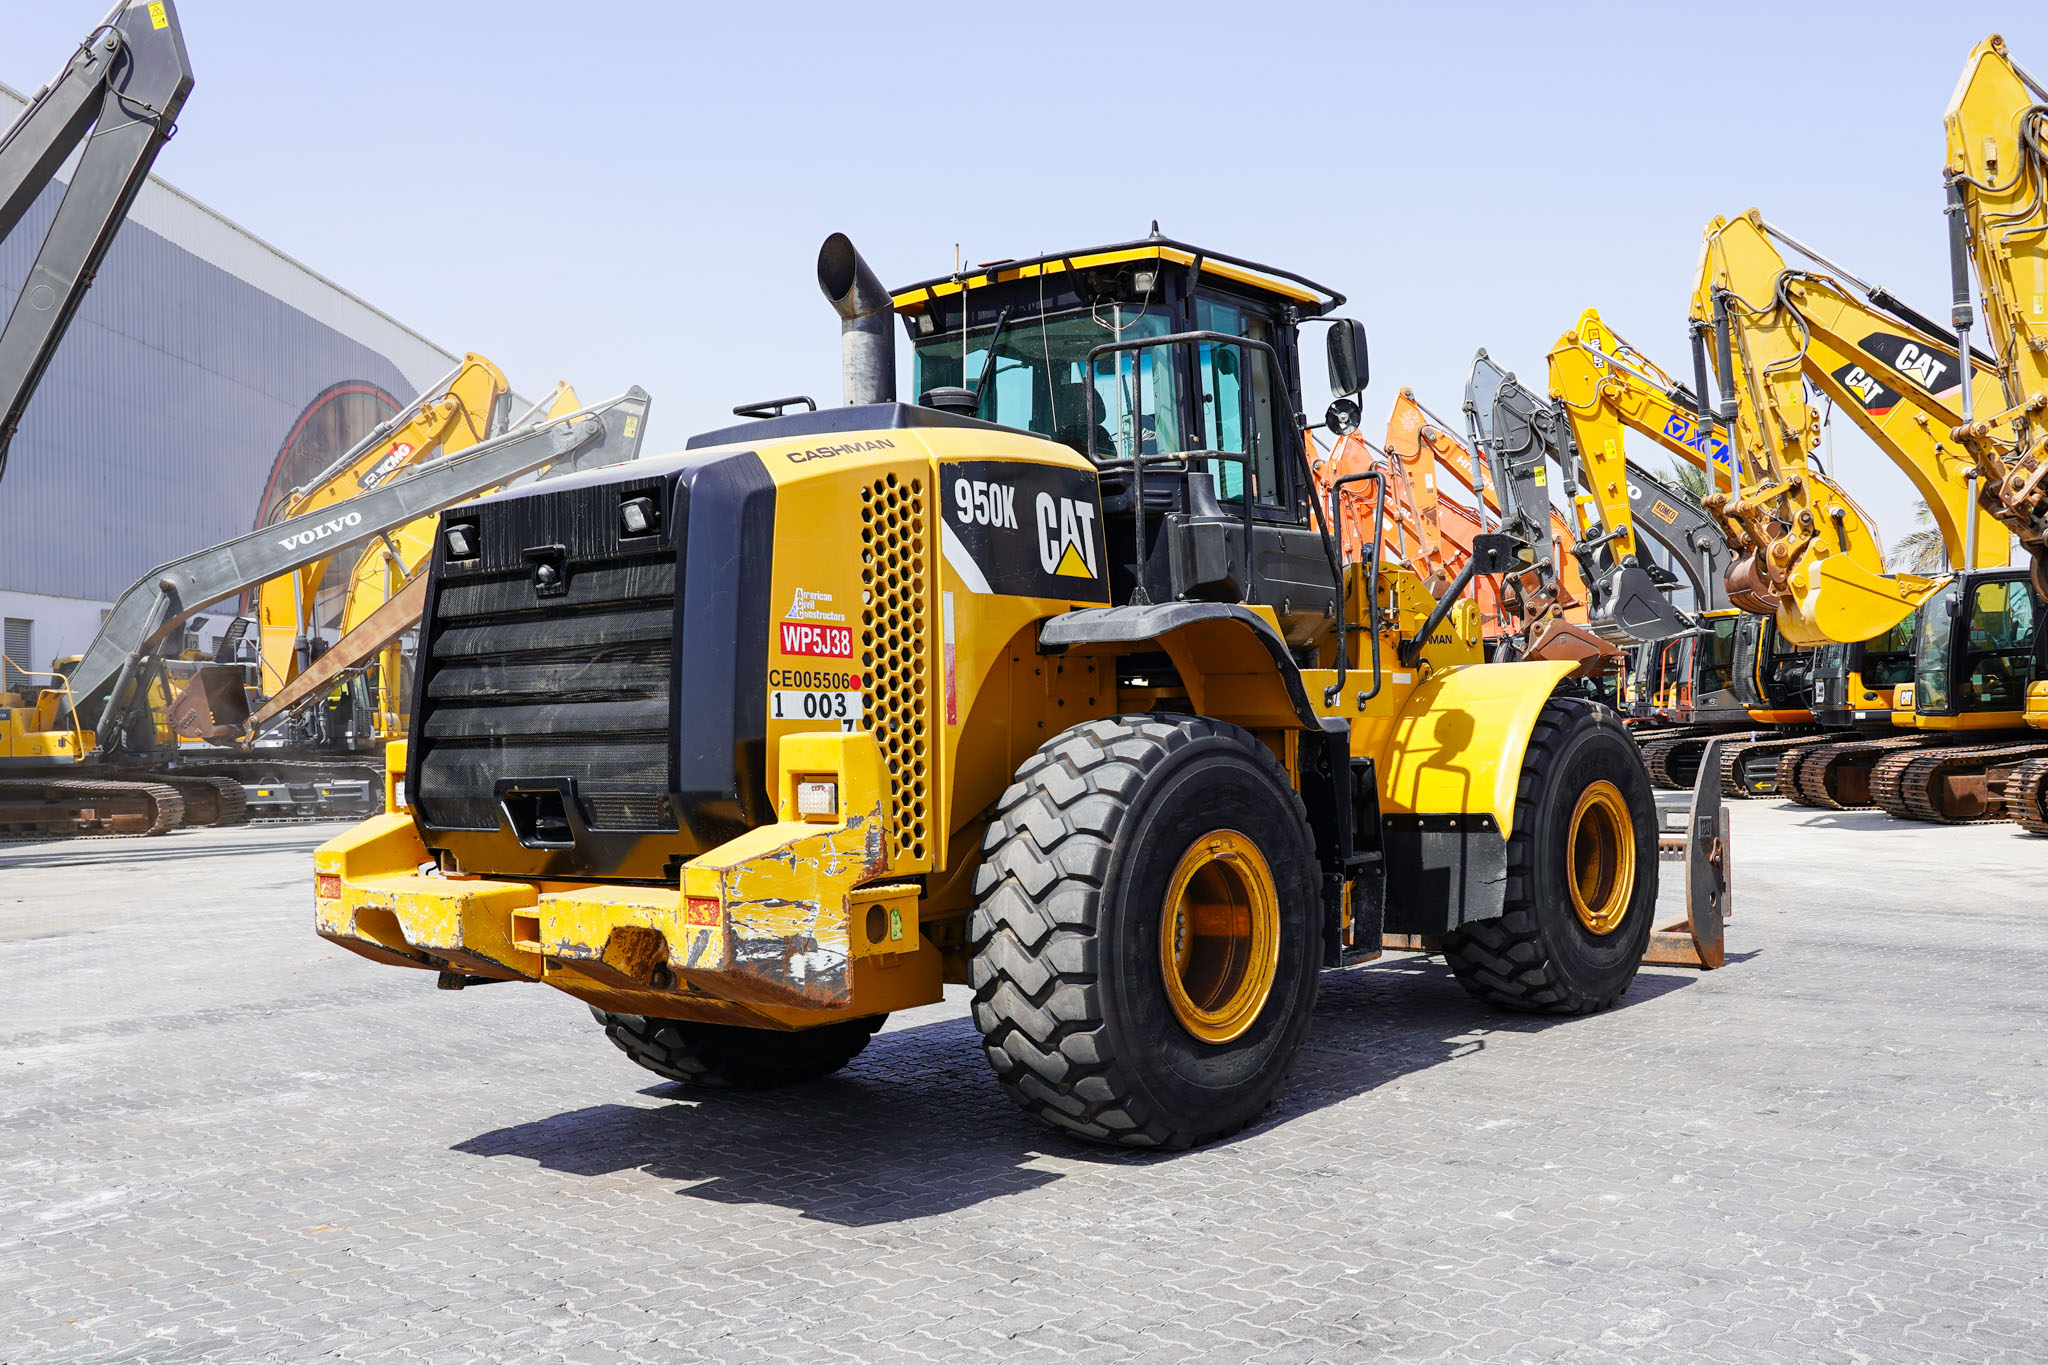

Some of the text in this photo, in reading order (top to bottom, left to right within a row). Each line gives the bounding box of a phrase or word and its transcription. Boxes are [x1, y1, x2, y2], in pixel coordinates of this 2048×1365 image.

[1894, 343, 1948, 389] CAT
[1844, 366, 1884, 405] CAT
[786, 439, 896, 463] CASHMAN
[1456, 455, 1496, 492] HITCHI
[954, 478, 1019, 530] 950K
[1655, 501, 1677, 520] ROMCO
[278, 511, 362, 551] VOLVO
[1035, 491, 1099, 580] CAT
[796, 588, 833, 603] American
[796, 598, 815, 611] Civil
[796, 608, 846, 622] Constructors
[782, 625, 851, 656] WP5J38
[769, 669, 850, 690] CE005506
[774, 692, 847, 719] 1 003
